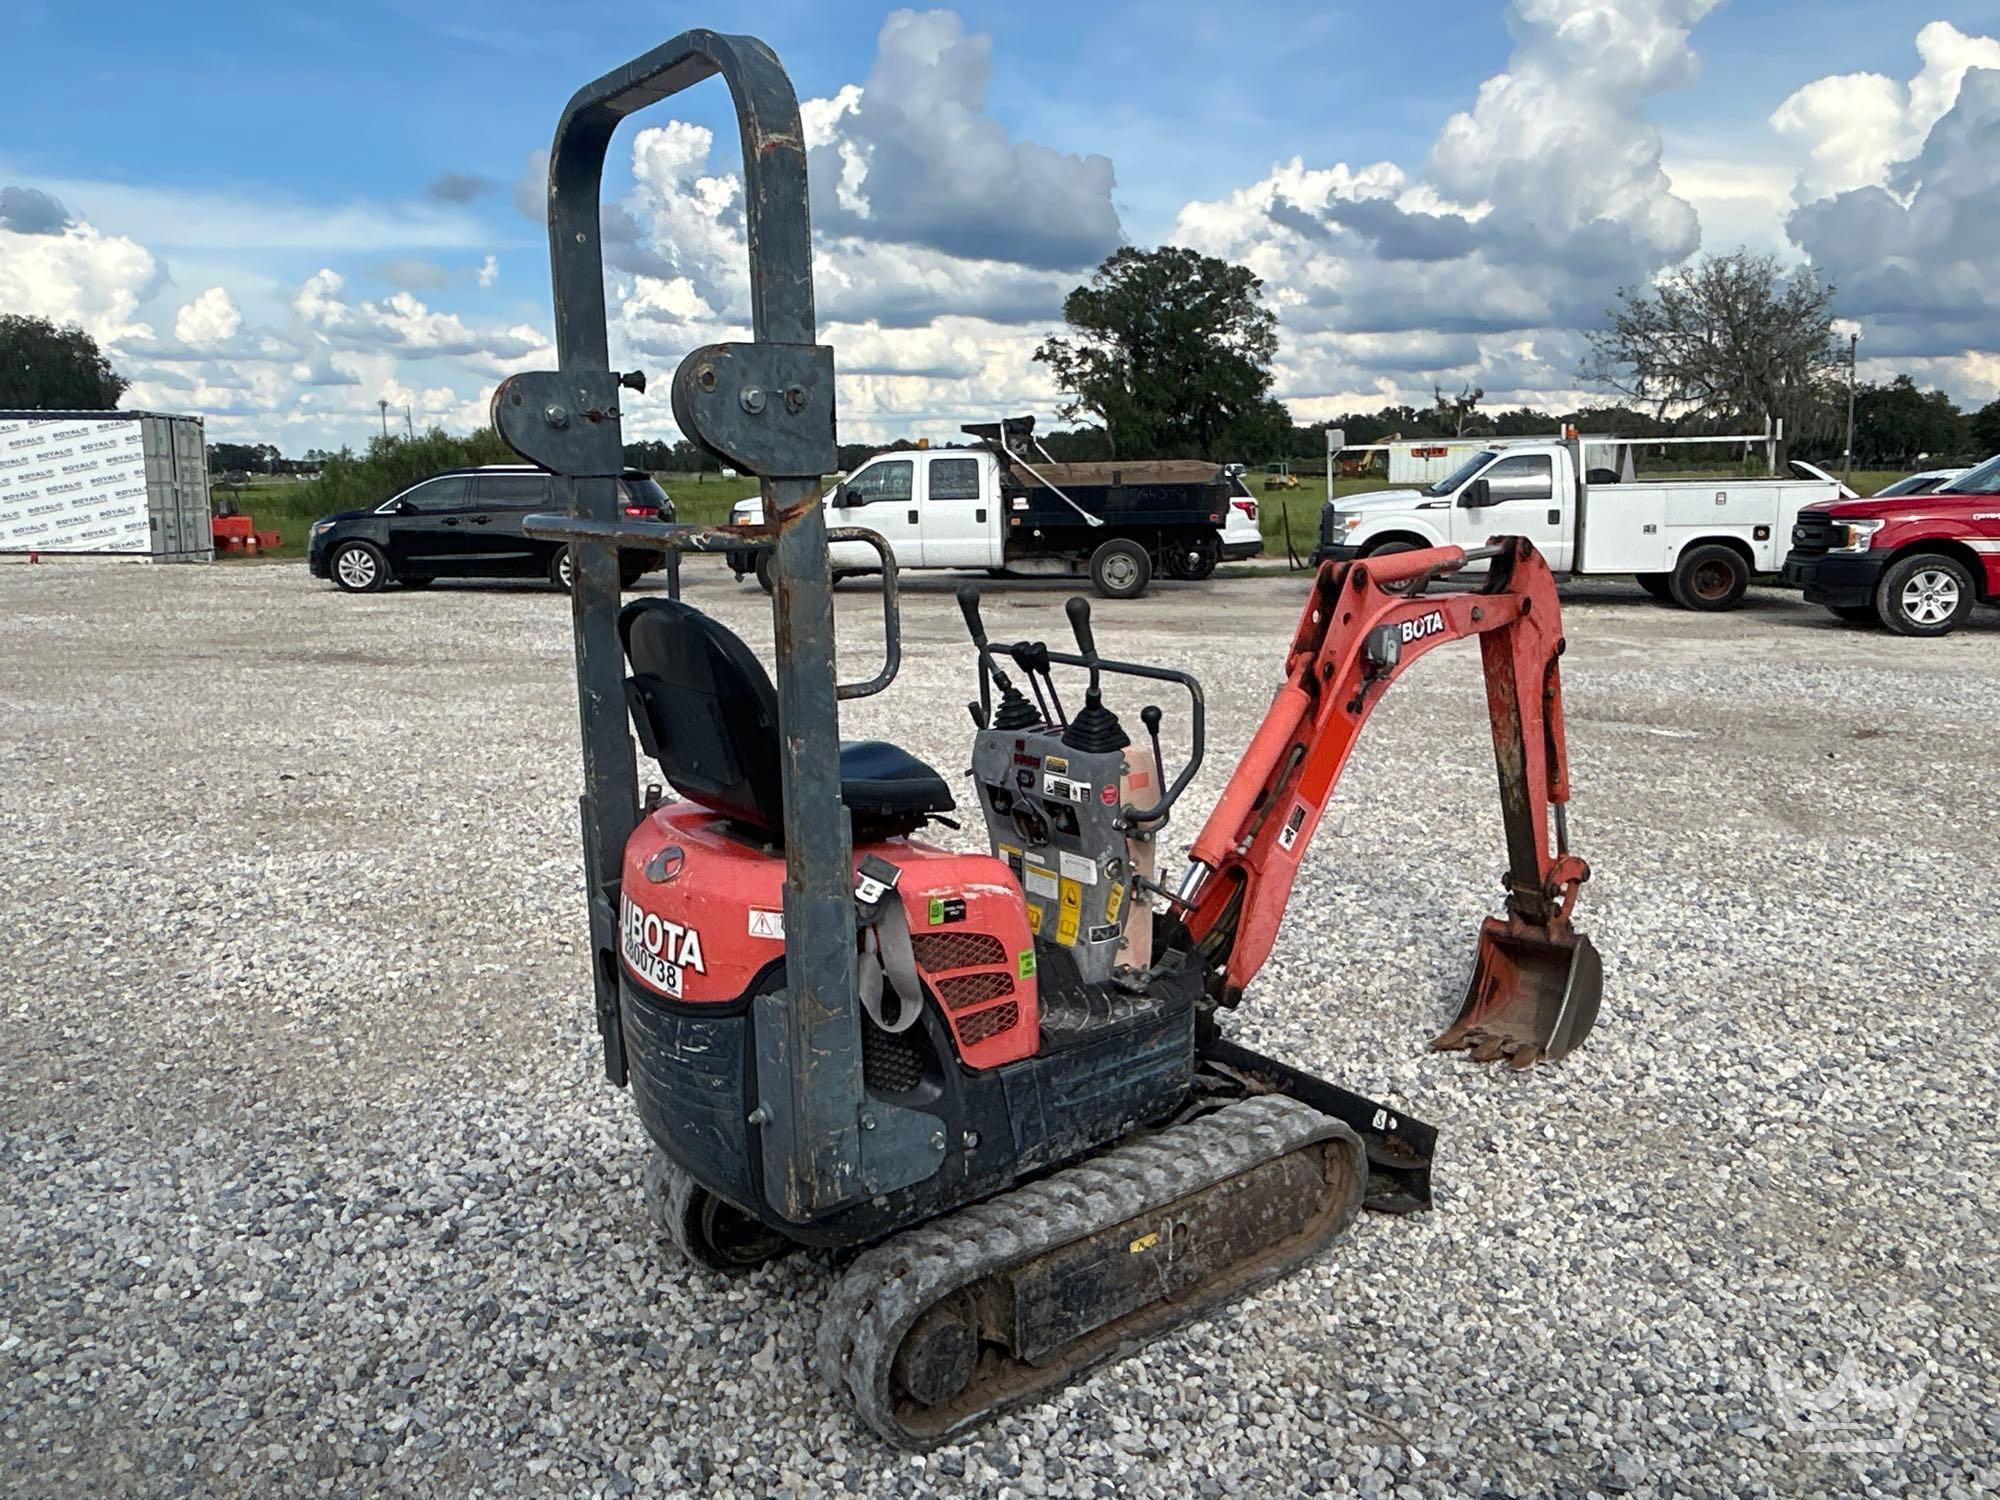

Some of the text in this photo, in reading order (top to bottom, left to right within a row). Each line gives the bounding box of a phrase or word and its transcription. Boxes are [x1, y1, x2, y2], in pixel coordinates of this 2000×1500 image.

[81, 440, 108, 450] ROYAL
[106, 454, 135, 463] ROYAL
[90, 474, 117, 484] ROYAL
[28, 504, 55, 513] ROYAL
[100, 507, 128, 517] ROYAL
[12, 525, 40, 534] ROYAL
[620, 892, 706, 975] UBOTA
